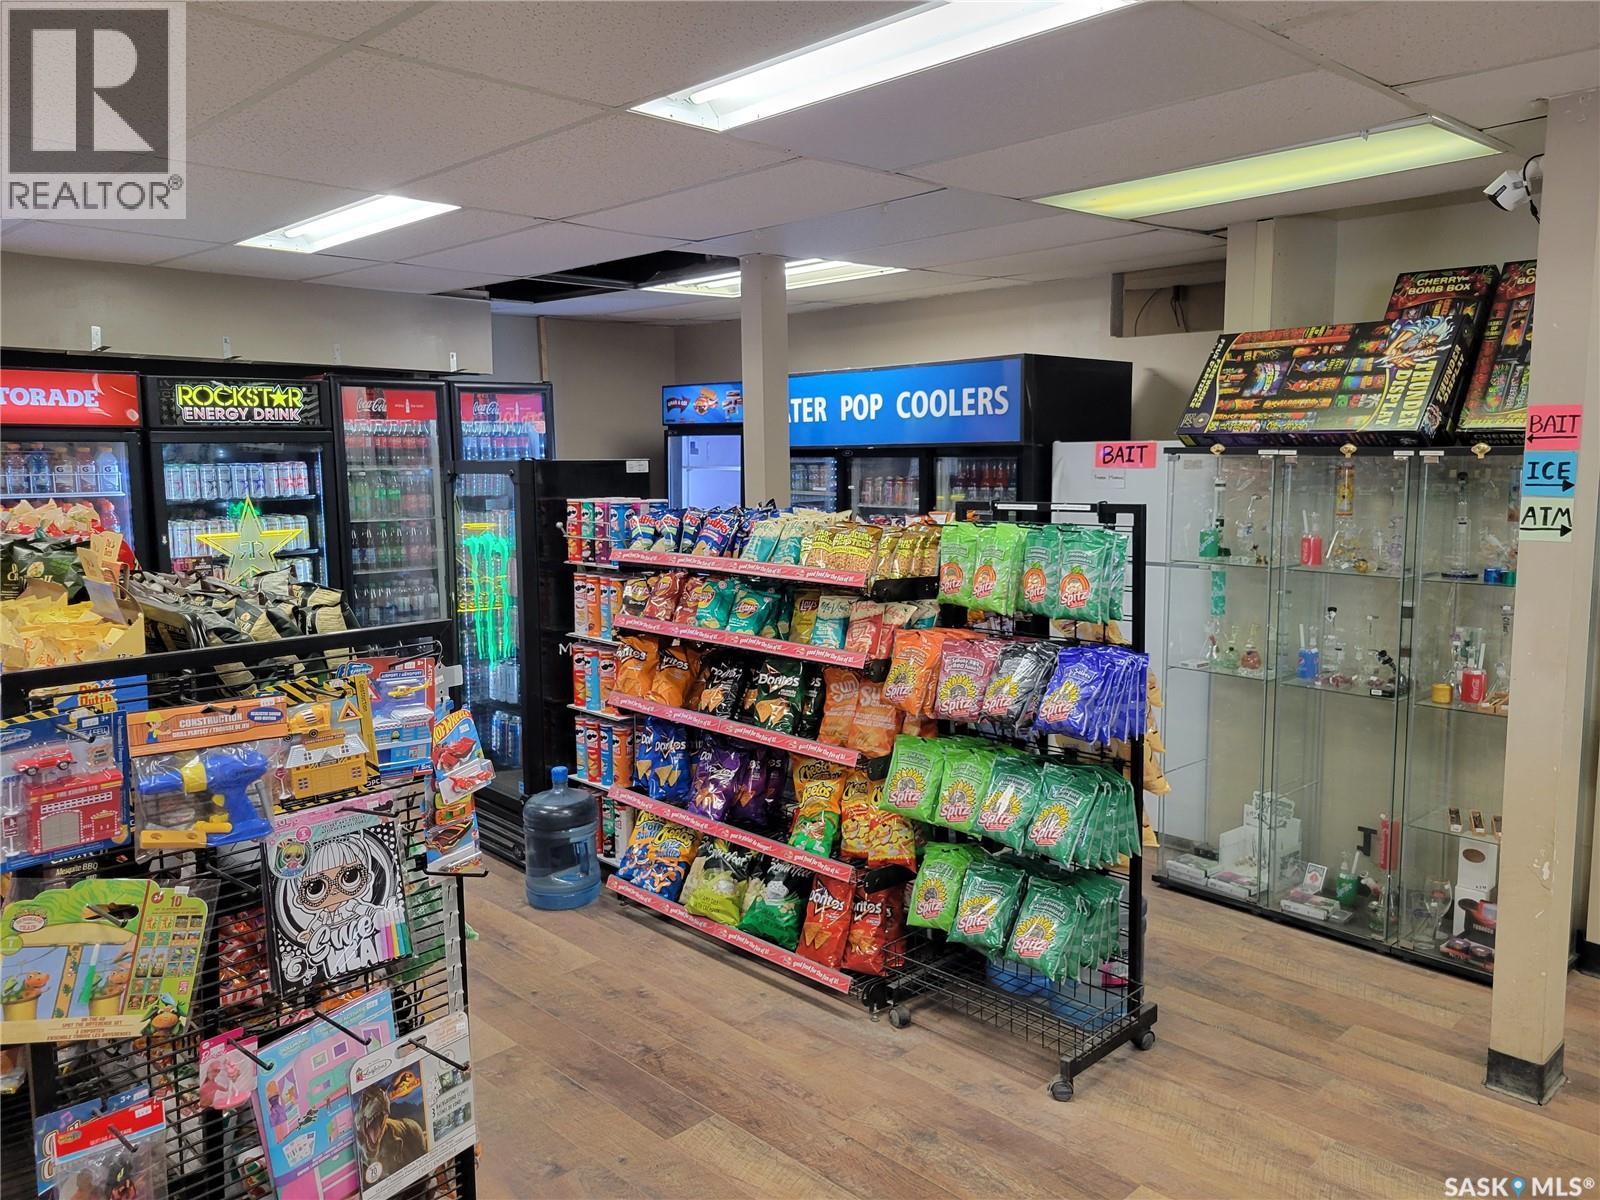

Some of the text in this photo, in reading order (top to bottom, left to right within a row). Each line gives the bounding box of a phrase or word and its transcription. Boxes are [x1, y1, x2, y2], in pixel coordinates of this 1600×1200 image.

[1408, 283, 1472, 295] BOMB BOX
[1416, 276, 1462, 286] CHERRY
[1437, 345, 1462, 402] THUNDER
[1376, 369, 1413, 426] DISPLAY
[1398, 360, 1438, 427] THUNDER
[840, 393, 883, 421] POP
[896, 385, 1010, 420] COOLERS
[183, 407, 300, 421] ENERGY DRINK
[1529, 415, 1582, 434] BAIT
[1102, 445, 1149, 465] BAIT
[1527, 461, 1572, 481] ICE
[1522, 507, 1573, 529] ATM
[973, 581, 995, 595] Spitz
[1024, 585, 1046, 600] Spitz
[1061, 591, 1090, 606] Spitz
[758, 674, 800, 688] Doritos
[885, 684, 912, 697] Spitz
[939, 697, 972, 714] Spitz
[982, 695, 1012, 711] Spitz
[1040, 701, 1073, 719] Spitz
[179, 713, 243, 728] CONSTRUCTION
[654, 738, 687, 751] Doritos
[888, 787, 922, 803] Spitz
[940, 802, 972, 818] Spitz
[979, 810, 1013, 826] Spitz
[1029, 825, 1062, 840] Spitz
[82, 862, 98, 871] BBQ
[170, 895, 183, 908] 10
[809, 888, 845, 911] Doritos
[916, 899, 943, 914] Spitz
[958, 912, 991, 928] Spitz
[1012, 936, 1048, 952] Spitz
